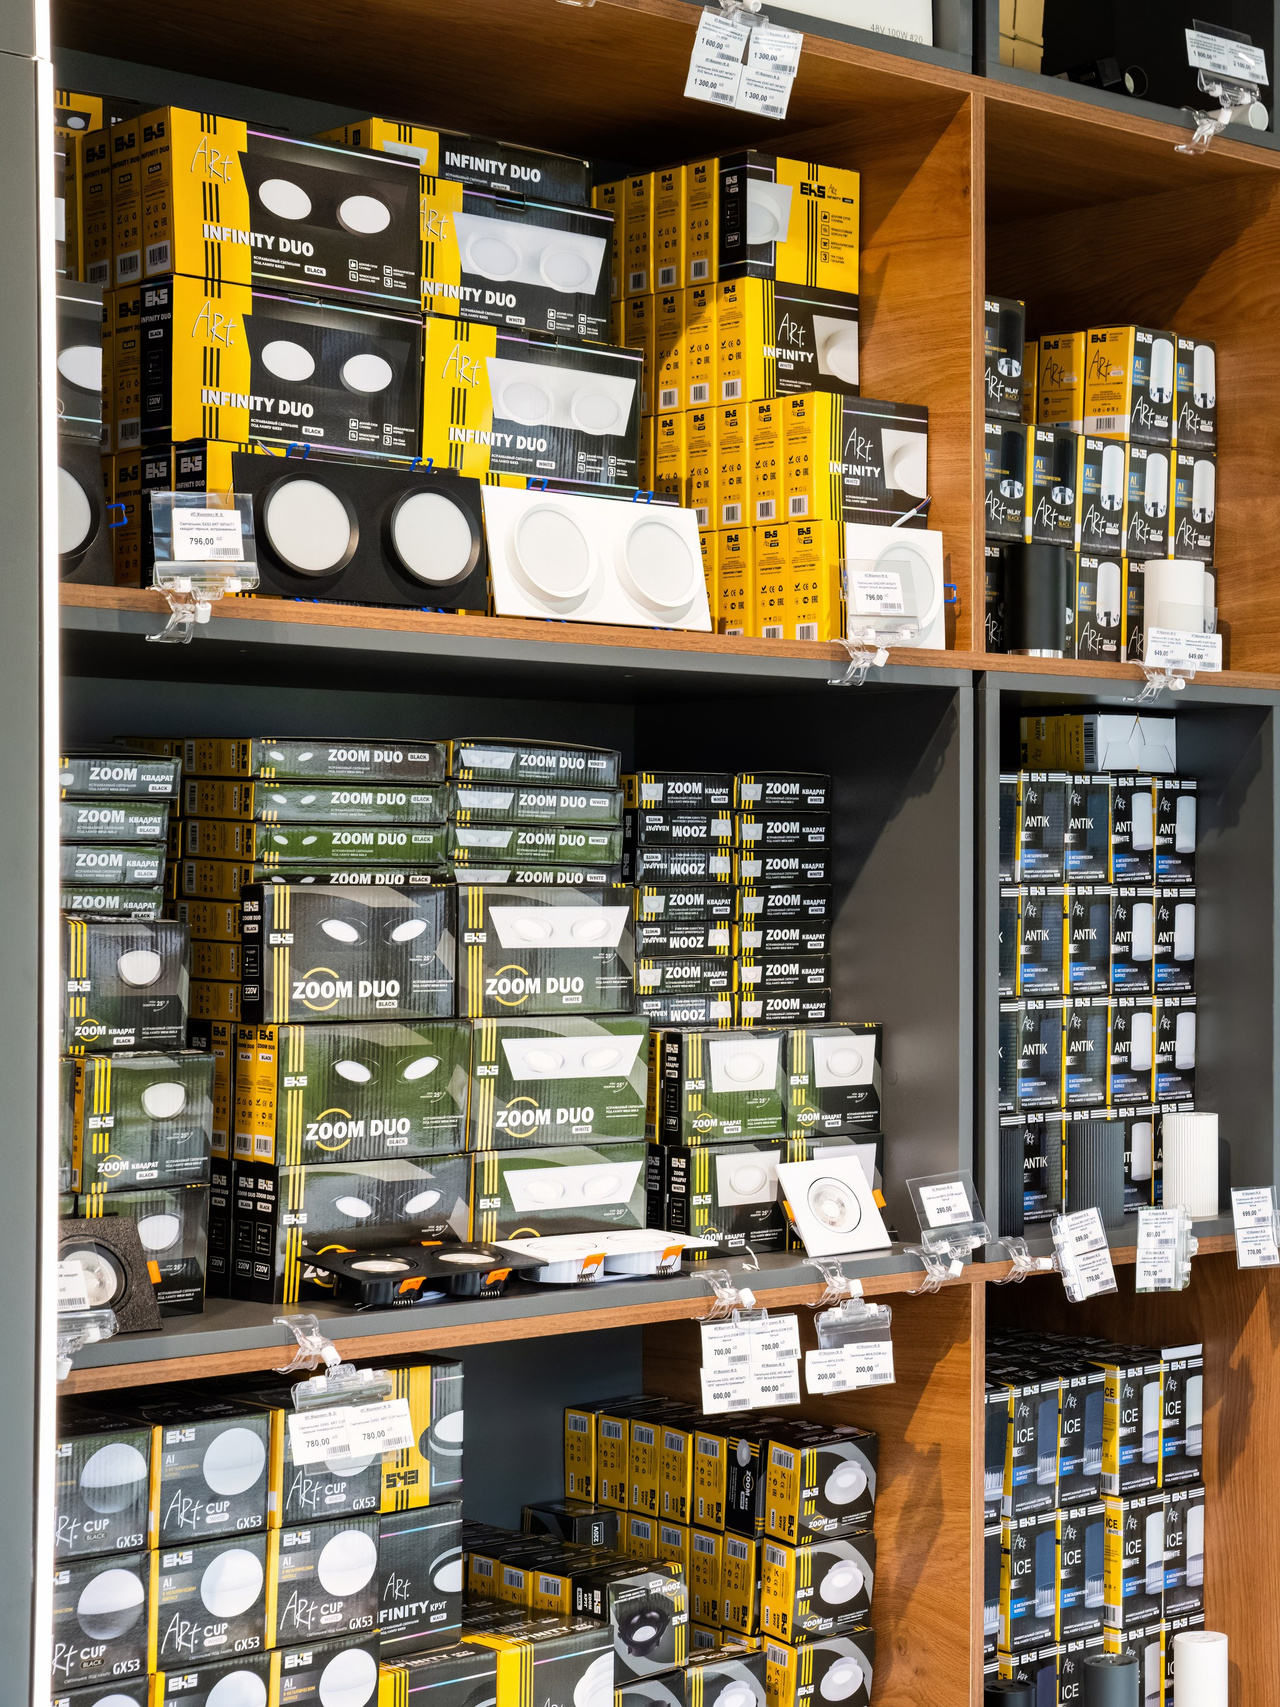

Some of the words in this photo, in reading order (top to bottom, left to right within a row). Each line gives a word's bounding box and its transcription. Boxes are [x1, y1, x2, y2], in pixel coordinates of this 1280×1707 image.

[871, 24, 885, 34] 48V
[887, 28, 907, 40] 100W
[445, 151, 507, 176] INFINITY
[510, 165, 541, 183] DUO
[202, 224, 275, 250] INFINITY
[279, 237, 314, 257] DUO
[306, 266, 324, 275] BLACK
[421, 281, 482, 303] INFINITY
[485, 291, 516, 308] DUO
[763, 346, 814, 364] INFINITY
[148, 396, 162, 406] 220V
[201, 389, 274, 414] INFINITY
[278, 399, 314, 418] DUO
[449, 427, 513, 449] INFINITY
[516, 435, 547, 452] DUO
[829, 461, 881, 478] INFINITY
[190, 537, 214, 546] 796,00
[328, 749, 371, 762] ZOOM
[374, 751, 403, 762] DUO
[520, 755, 556, 767] ZOOM
[560, 757, 585, 769] DUO
[90, 768, 137, 780] ZOOM
[667, 782, 702, 794] ZOOM
[766, 784, 800, 794] ZOOM
[78, 810, 125, 823] ZOOM
[1025, 816, 1050, 827] ANTIK
[1069, 818, 1093, 829] ANTIK
[672, 826, 706, 837] ZOOM
[332, 833, 374, 845] ZOOM
[378, 833, 407, 845] DUO
[518, 833, 555, 845] ZOOM
[559, 834, 585, 846] DUO
[76, 854, 123, 866] ZOOM
[766, 858, 799, 870] ZOOM
[72, 896, 120, 909] ZOOM
[1025, 930, 1049, 941] ANTIK
[1074, 929, 1096, 940] ANTIK
[766, 964, 799, 976] ZOOM
[293, 980, 354, 1000] ZOOM
[358, 980, 400, 998] DUO
[486, 979, 540, 996] ZOOM
[546, 977, 584, 993] DUO
[766, 999, 800, 1010] ZOOM
[75, 1026, 106, 1036] ZOOM
[1022, 1044, 1048, 1055] ANTIK
[1070, 1040, 1094, 1052] ANTIK
[496, 1110, 551, 1128] ZOOM
[556, 1107, 594, 1124] DUO
[693, 1118, 718, 1128] ZOOM
[797, 1112, 820, 1123] ZOOM
[306, 1120, 364, 1141] ZOOM
[370, 1118, 410, 1136] DUO
[97, 1161, 129, 1172] ZOOM
[1024, 1156, 1048, 1169] ANTIK
[936, 1205, 952, 1213] 280,00
[255, 1265, 268, 1273] 220V
[1165, 1401, 1181, 1415] ICE
[1122, 1409, 1139, 1423] ICE
[362, 1430, 386, 1441] 780,00
[306, 1437, 330, 1448] 780,00
[324, 1482, 347, 1496] CUP
[206, 1501, 230, 1514] CUP
[353, 1496, 376, 1510] GX53
[83, 1518, 110, 1533] CUP
[236, 1515, 262, 1530] GX53
[116, 1534, 144, 1549] GX53
[1167, 1532, 1182, 1547] ICE
[1126, 1539, 1142, 1555] ICE
[1064, 1550, 1082, 1566] ICE
[1014, 1559, 1032, 1575] ICE
[320, 1601, 344, 1615] CUP
[349, 1615, 373, 1630] GX53
[204, 1622, 228, 1638] CUP
[234, 1637, 260, 1651] GX53
[80, 1646, 106, 1660] CUP
[113, 1660, 140, 1675] GX53
